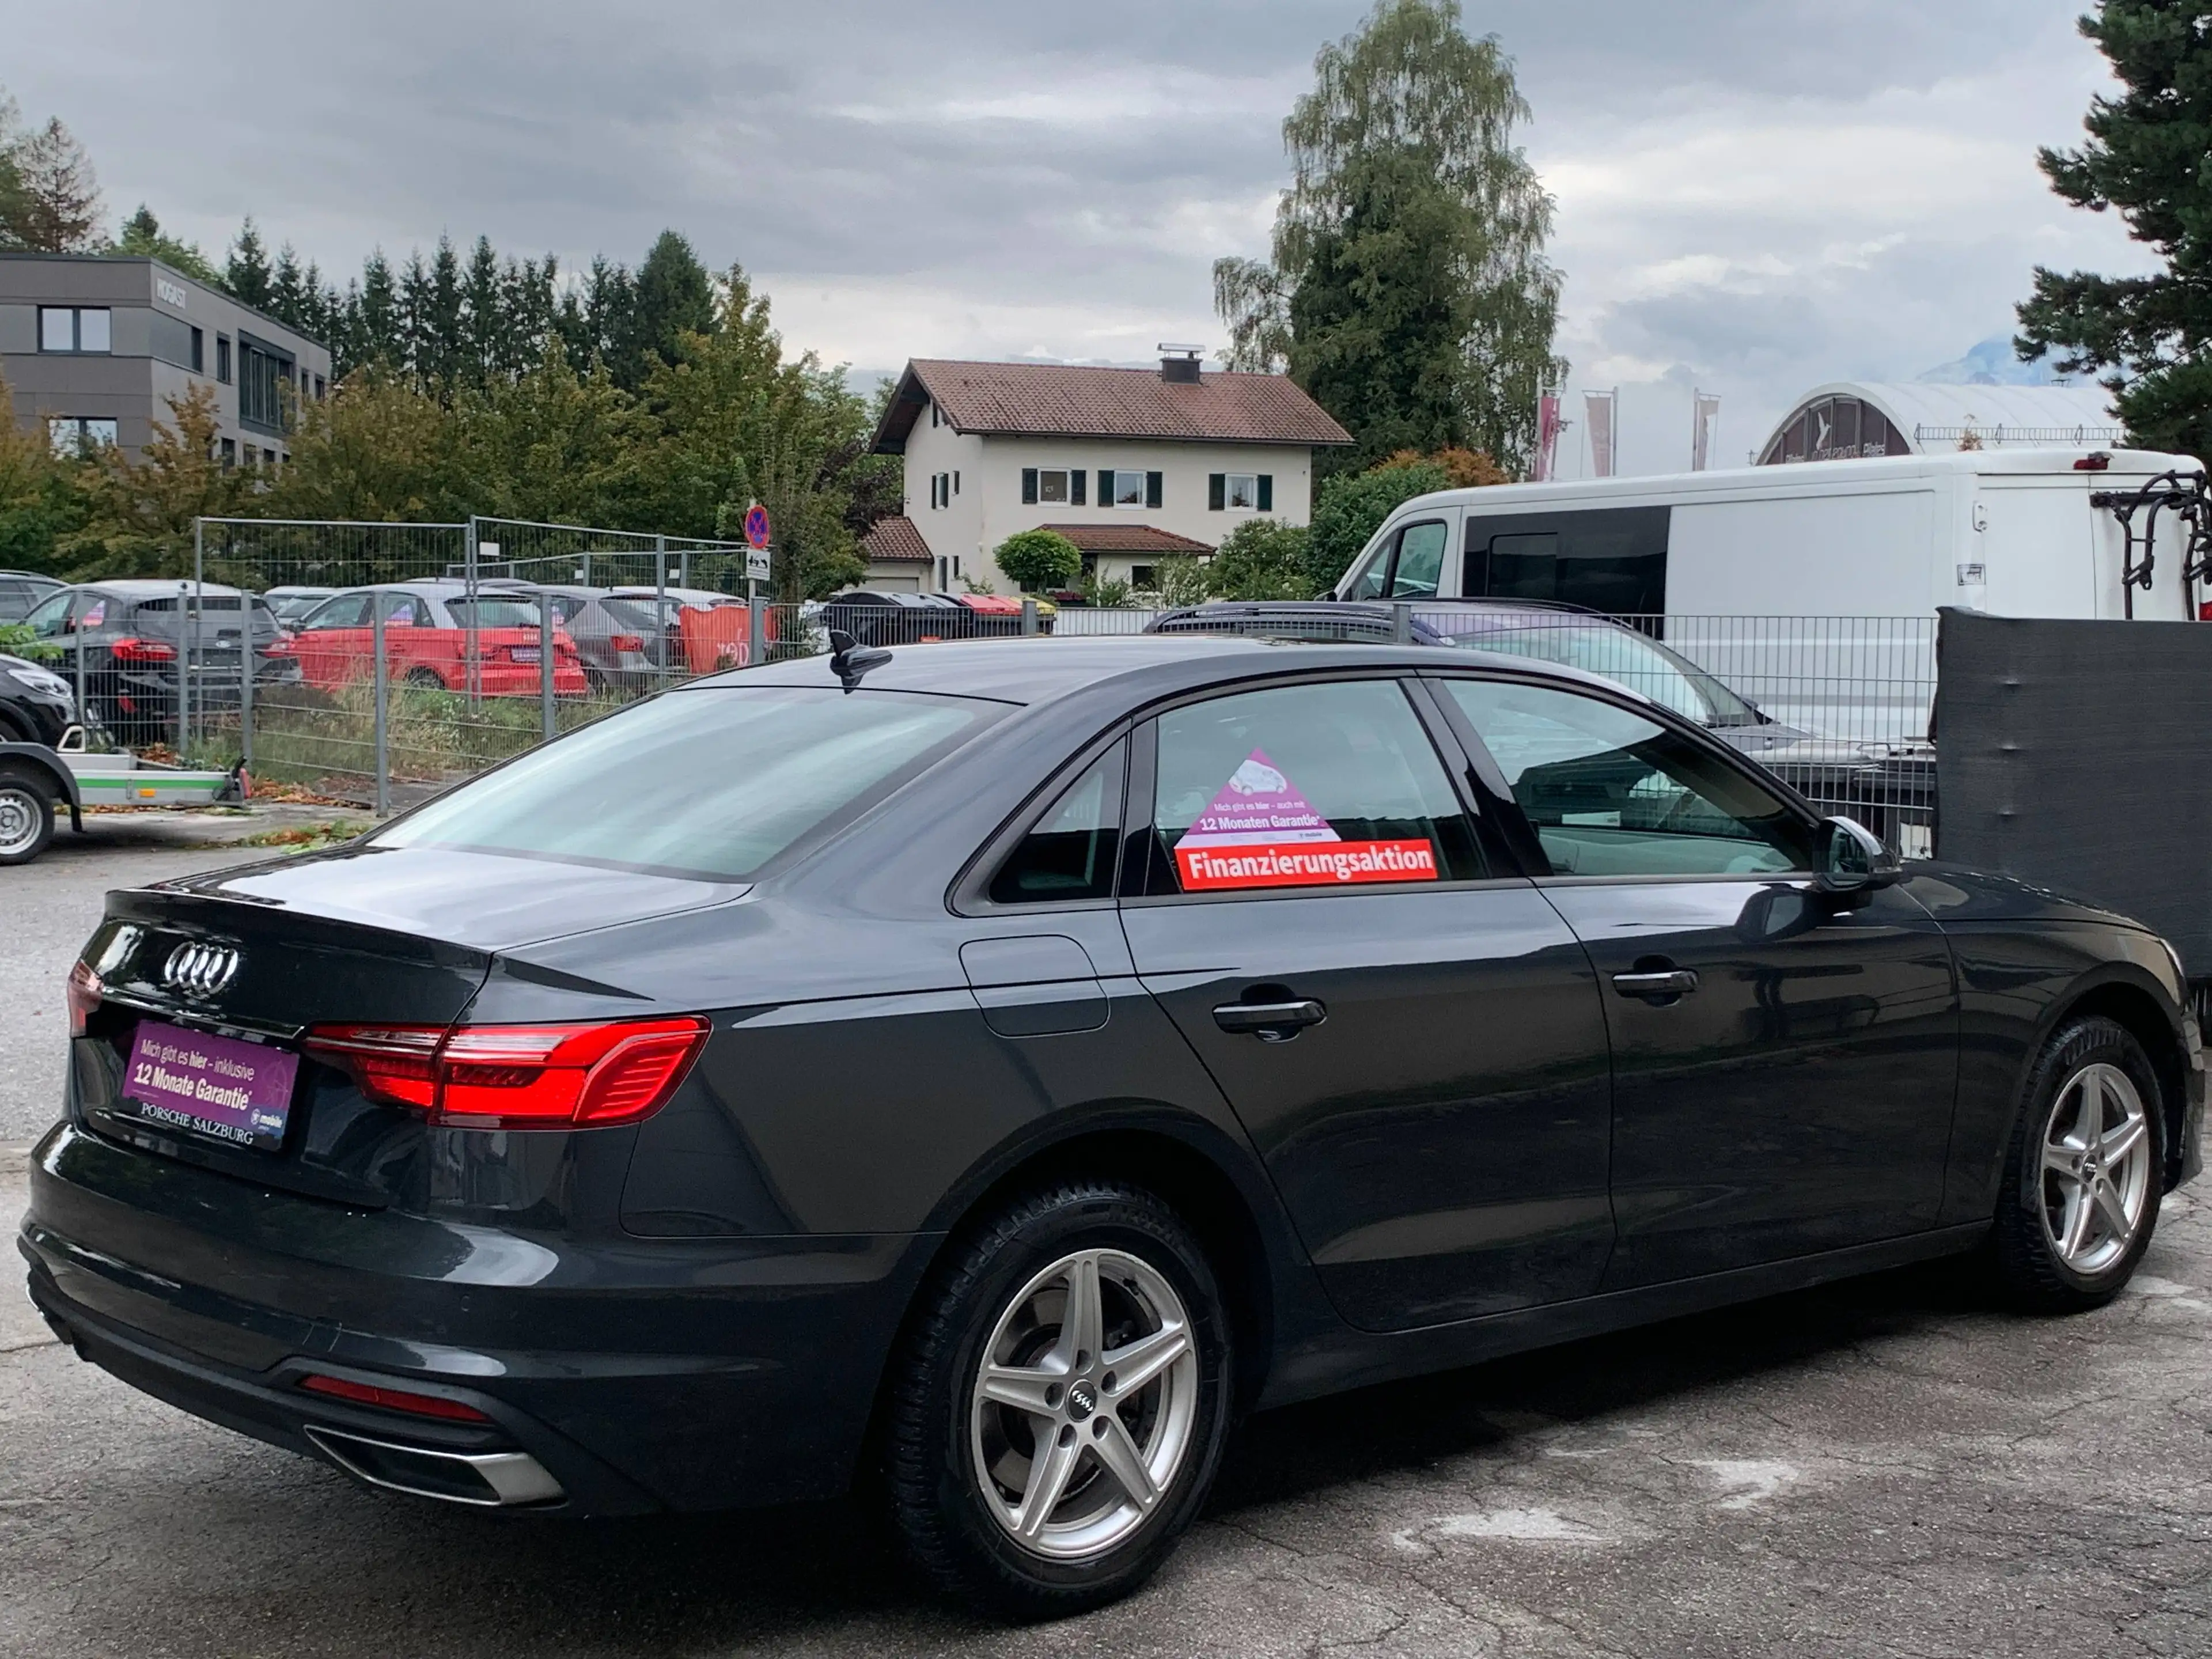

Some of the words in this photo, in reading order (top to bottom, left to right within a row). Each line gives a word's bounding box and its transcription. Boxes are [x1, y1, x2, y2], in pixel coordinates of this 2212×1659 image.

[1200, 817, 1218, 831] 12
[1218, 815, 1268, 830] Monaten
[1188, 844, 1433, 880] Finanzierungsaktion
[141, 1039, 161, 1058] Mich
[161, 1044, 178, 1063] gibt
[178, 1051, 188, 1066] es
[189, 1050, 208, 1070] hier
[214, 1056, 255, 1082] inklusive
[134, 1062, 153, 1085] 12
[151, 1066, 194, 1097] Monate
[141, 1102, 191, 1127] PORSCHE
[192, 1116, 254, 1145] SALZBURG
